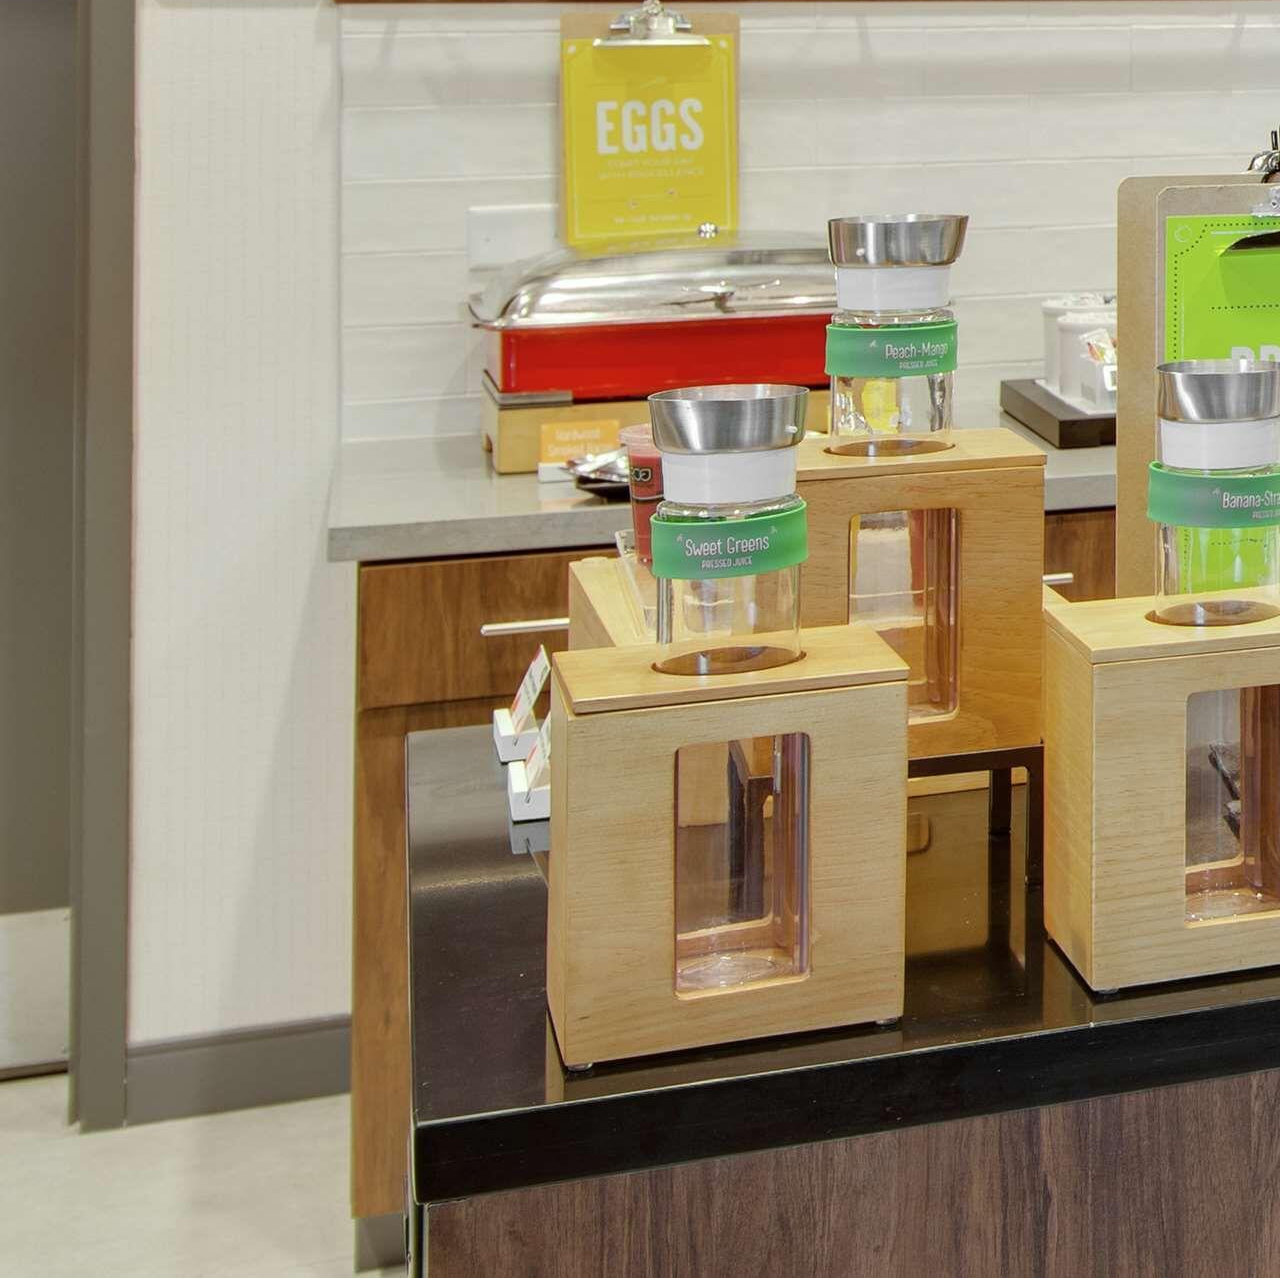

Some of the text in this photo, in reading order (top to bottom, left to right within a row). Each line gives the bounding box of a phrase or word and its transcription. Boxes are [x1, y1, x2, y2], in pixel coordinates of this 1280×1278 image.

[596, 98, 704, 154] EGGS
[885, 341, 949, 359] Peach-Mango
[685, 536, 770, 557] Sweet Greens
[702, 556, 753, 570] PRESSED JUICE
